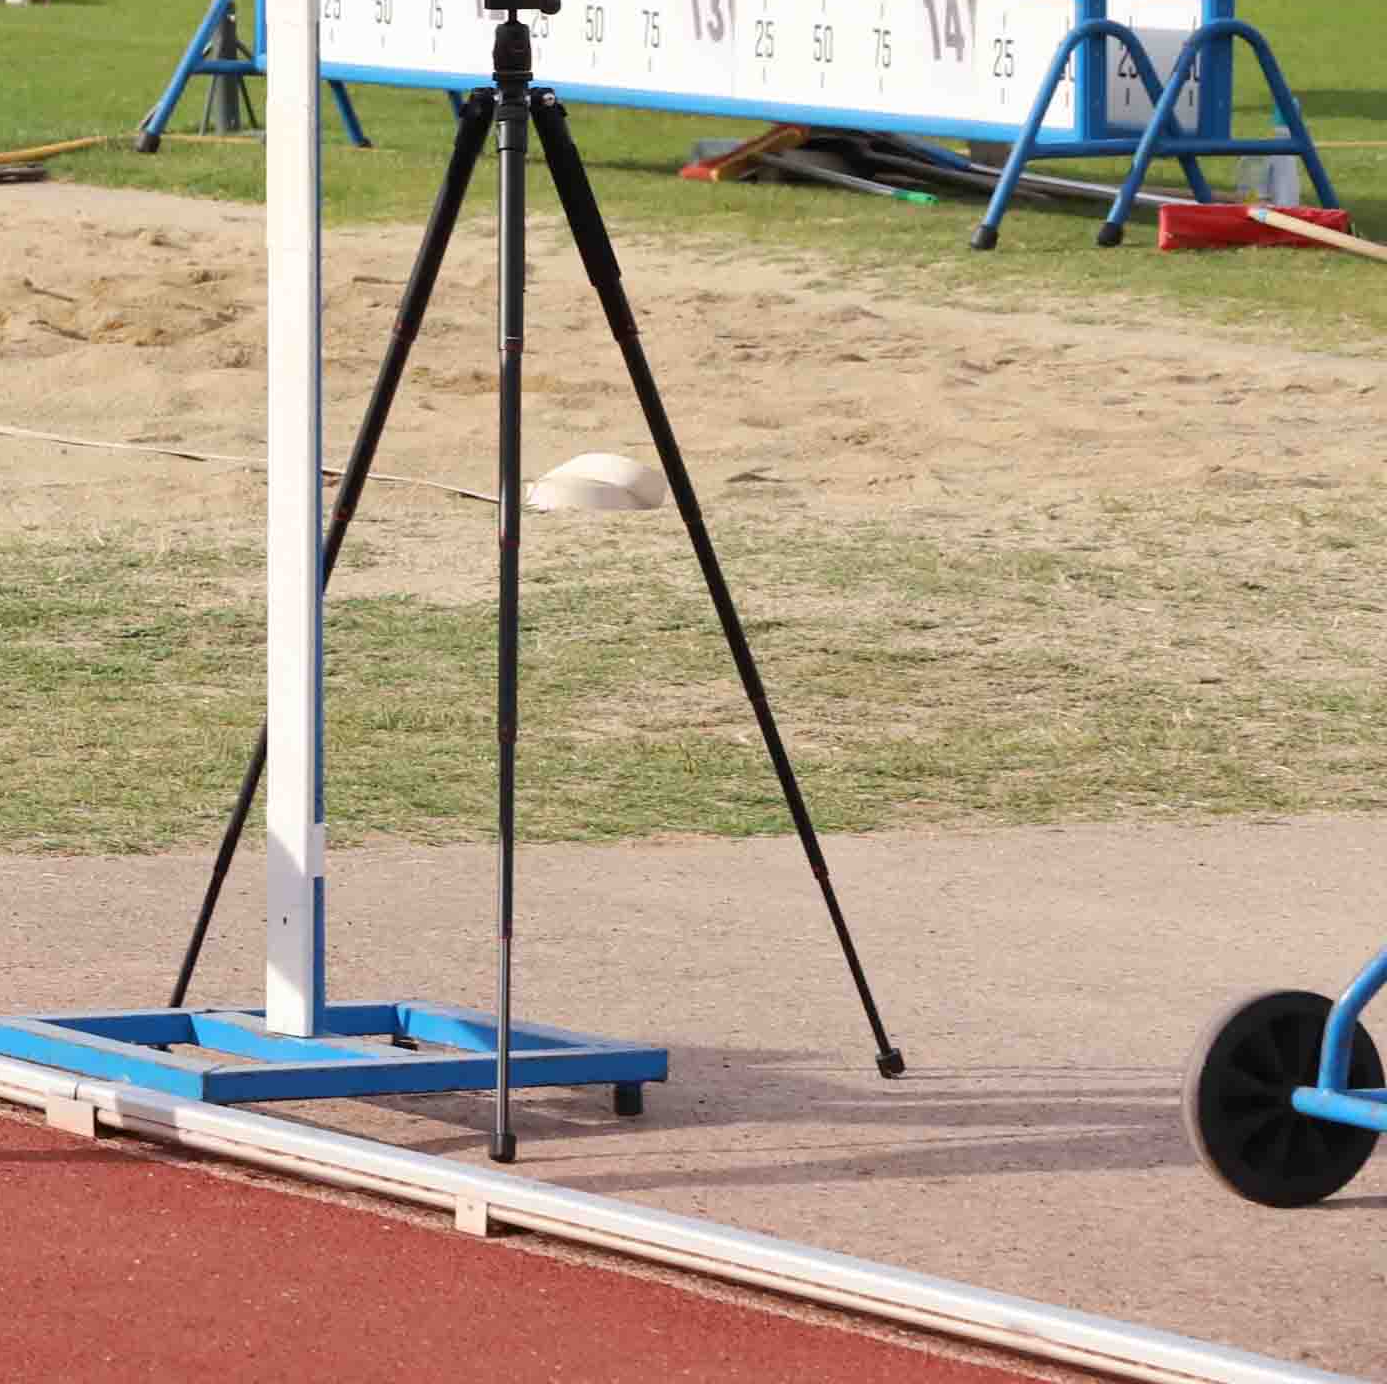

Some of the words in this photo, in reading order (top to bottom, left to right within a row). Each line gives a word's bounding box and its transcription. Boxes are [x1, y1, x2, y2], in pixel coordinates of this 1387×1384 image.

[585, 4, 604, 43] 50
[642, 9, 661, 48] 75
[754, 19, 775, 58] 25
[812, 24, 834, 63] 50
[873, 28, 892, 68] 75
[992, 37, 1016, 78] 25
